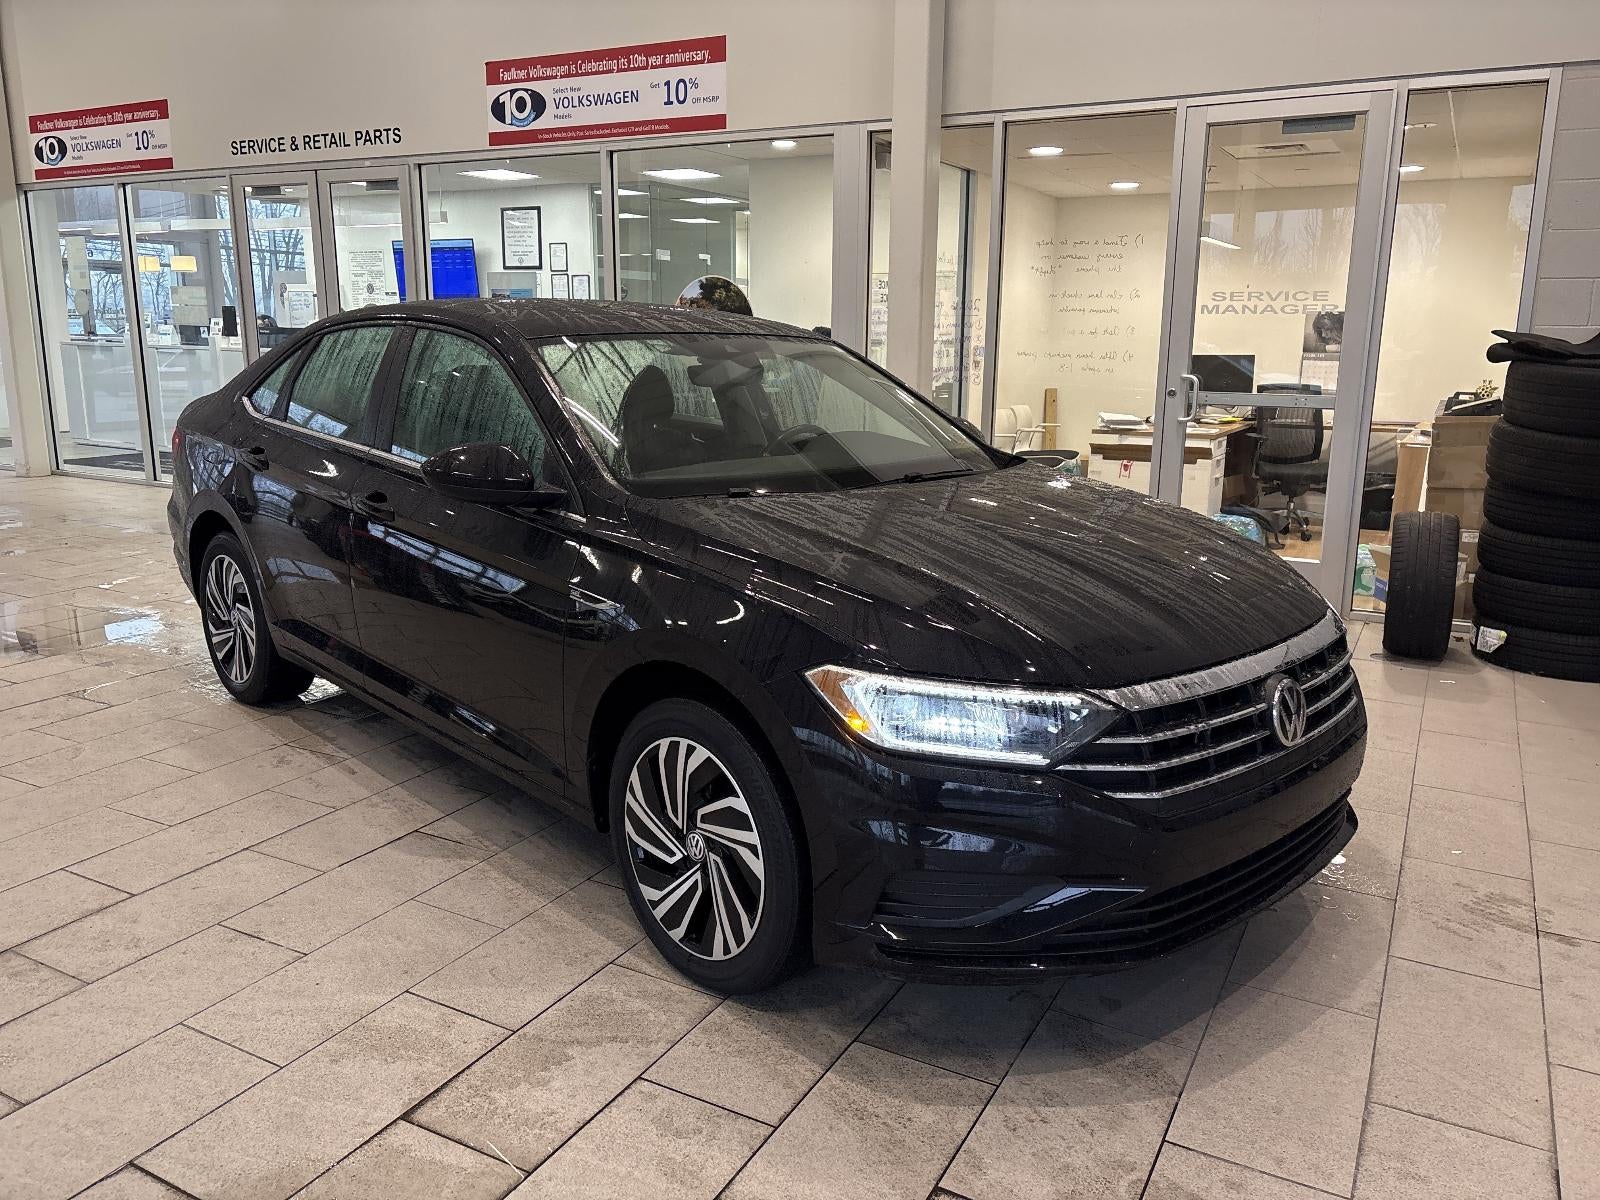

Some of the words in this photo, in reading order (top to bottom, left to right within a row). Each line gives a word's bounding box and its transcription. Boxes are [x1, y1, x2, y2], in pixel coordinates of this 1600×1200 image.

[500, 68, 527, 81] Faulkner
[528, 64, 569, 79] Volkswagen
[570, 61, 576, 74] is
[577, 57, 617, 73] Celebrating
[629, 53, 647, 68] 10th
[647, 53, 663, 70] year
[665, 49, 711, 64] anniversary.
[499, 90, 532, 125] 10
[553, 90, 639, 110] VOLKSWAGEN
[702, 95, 720, 104] MSRP
[79, 116, 83, 126] is
[83, 113, 106, 126] Celebrating
[124, 111, 133, 123] year
[71, 138, 122, 152] VOLKSWAGEN
[231, 137, 286, 156] SERVICE
[290, 136, 299, 151] &
[303, 132, 351, 150] RETAIL
[354, 127, 402, 147] PARTS
[39, 137, 59, 164] 10
[1211, 290, 1330, 302] SERVICE
[1200, 303, 1340, 315] MANAGER
